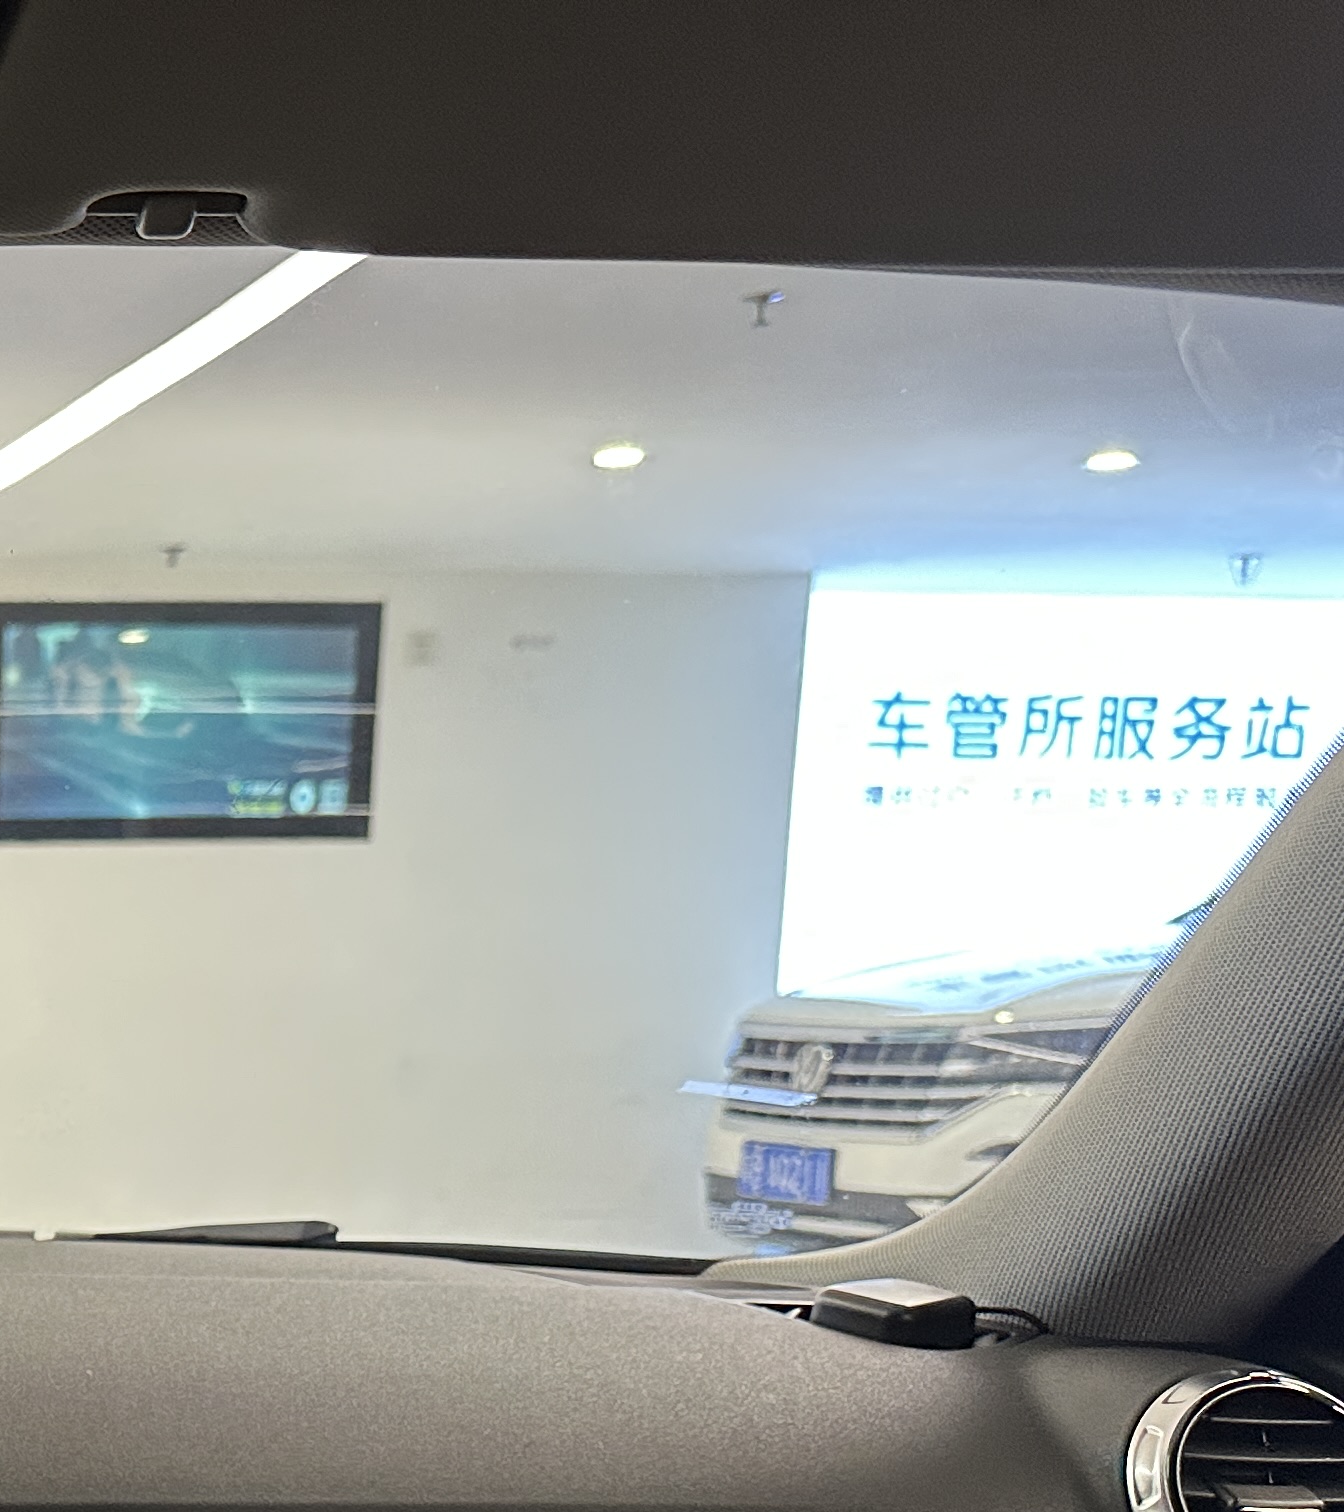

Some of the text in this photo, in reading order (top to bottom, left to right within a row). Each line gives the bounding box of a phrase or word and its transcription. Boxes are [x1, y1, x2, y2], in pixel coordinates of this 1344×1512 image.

[868, 692, 1311, 760] 车管所服务站
